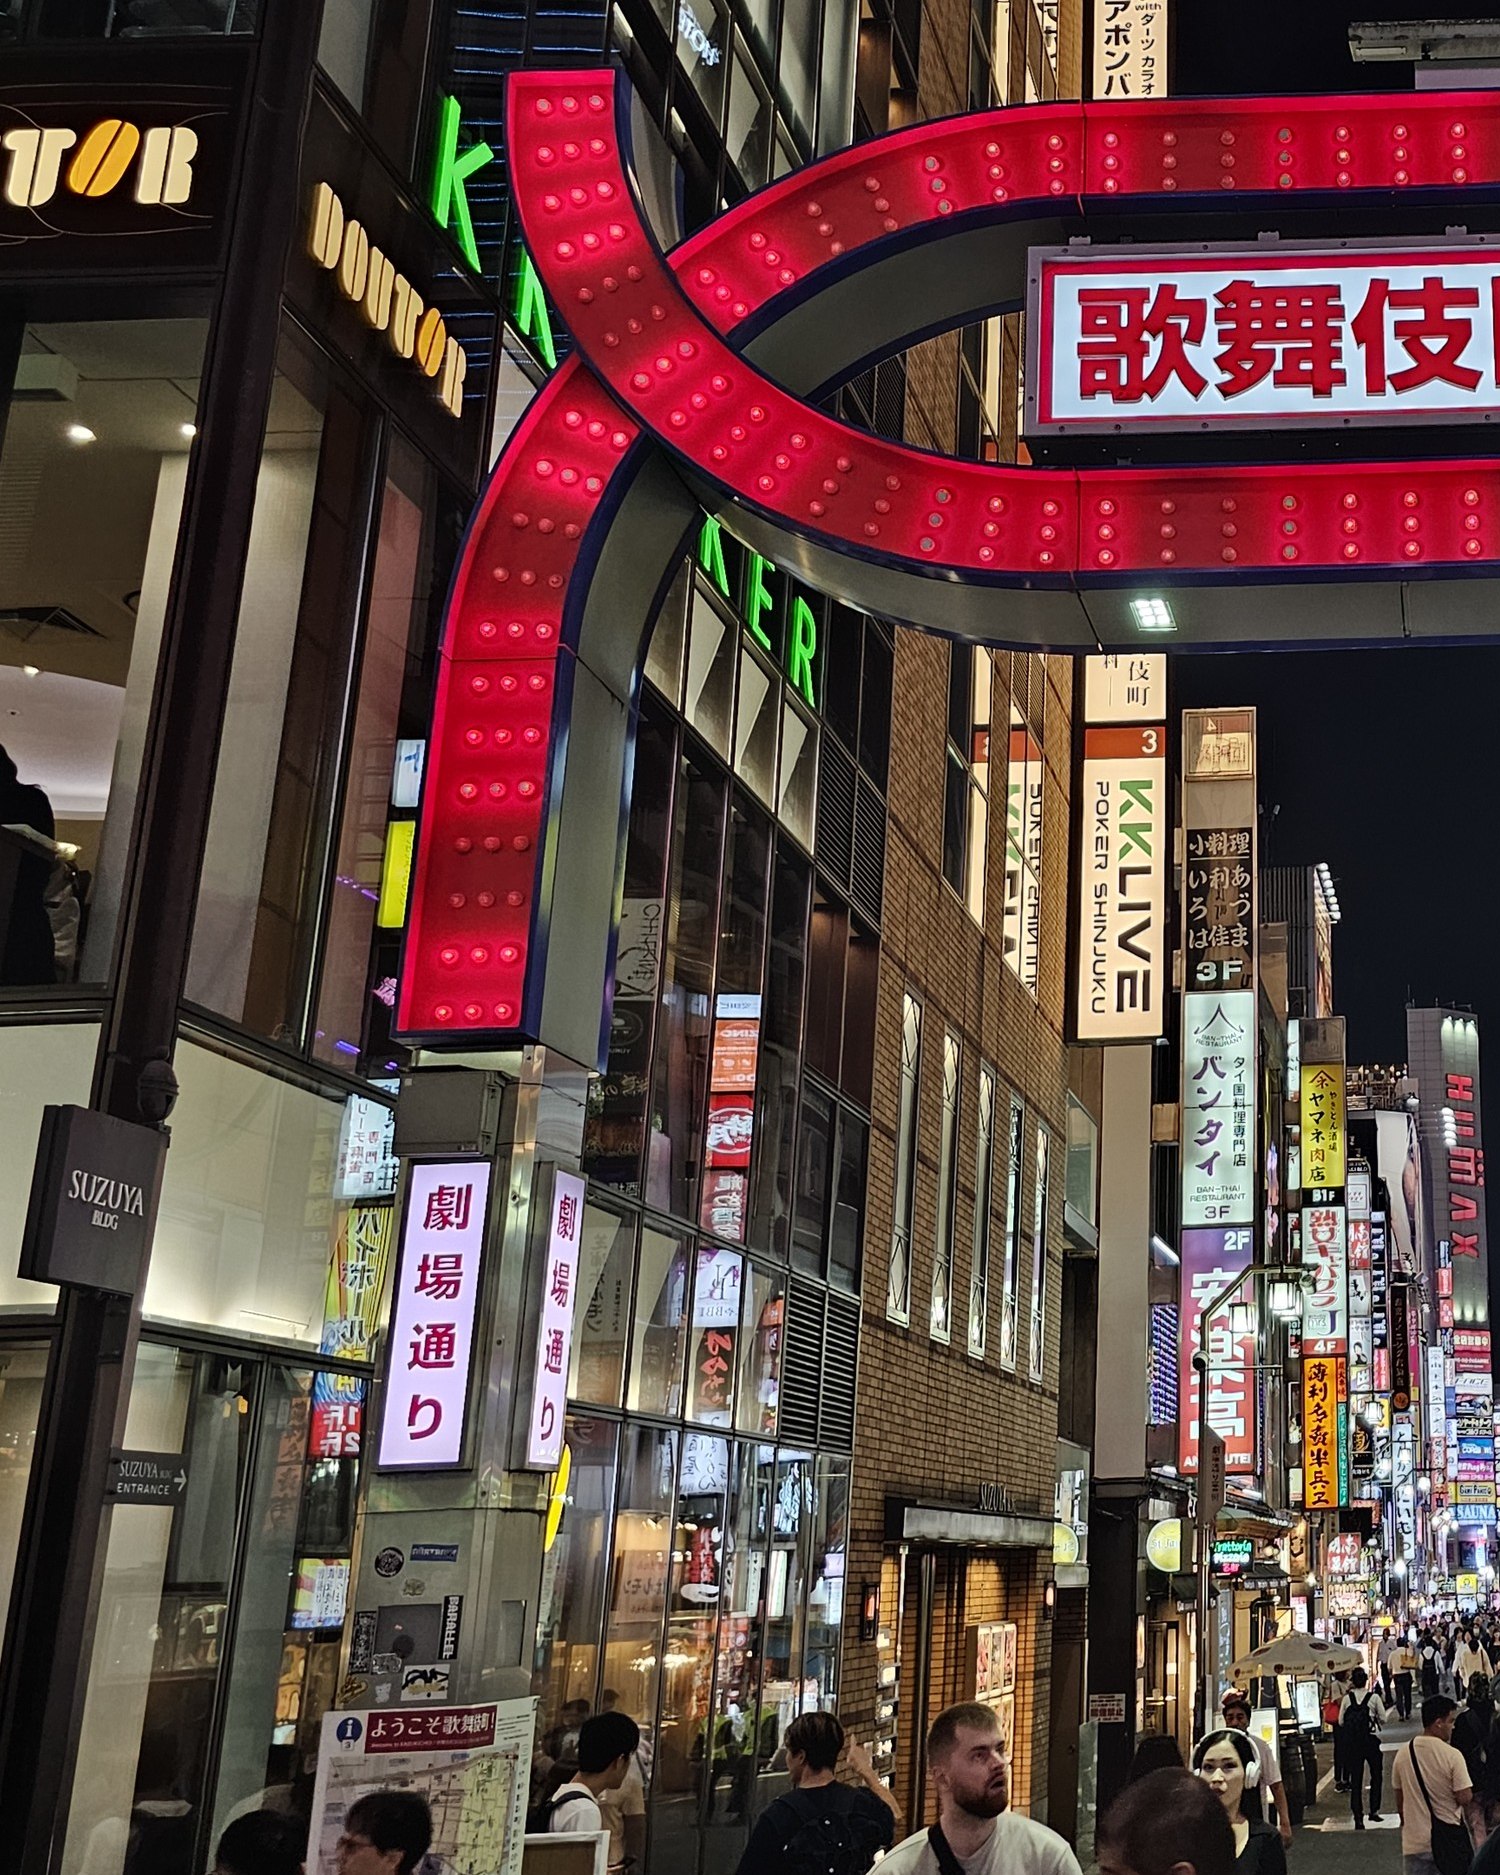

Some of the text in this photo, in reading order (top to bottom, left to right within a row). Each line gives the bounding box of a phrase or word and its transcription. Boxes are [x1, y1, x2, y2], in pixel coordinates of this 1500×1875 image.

[311, 181, 467, 418] DOUTOR
[1142, 731, 1157, 753] 3
[1189, 832, 1250, 856] 小料理
[1091, 781, 1110, 1014] POKER SHINJUKU
[1117, 780, 1154, 1012] KKLIVE
[1196, 960, 1243, 982] 3F
[1192, 1055, 1227, 1176] バンタイ
[1232, 1056, 1247, 1167] タイ国料理専門店
[1309, 1092, 1327, 1182] ヤマネ肉店
[68, 1170, 143, 1216] SUZUYA
[1189, 1193, 1245, 1202] RESTAURANT
[1196, 1184, 1241, 1194] BAN-THAI
[1312, 1189, 1335, 1202] B1F
[92, 1210, 118, 1230] BLDG
[1204, 1205, 1230, 1219] 3F
[1224, 1230, 1250, 1251] 2F
[407, 1184, 473, 1440] 劇場通り
[540, 1193, 576, 1441] 劇場通り
[1314, 1341, 1336, 1352] 4F
[119, 1461, 158, 1479] SUZUYA
[117, 1482, 169, 1495] ENTRANCE
[1457, 1505, 1495, 1519] SAUNA
[371, 1712, 495, 1737] ようこそ歌舞伎町!
